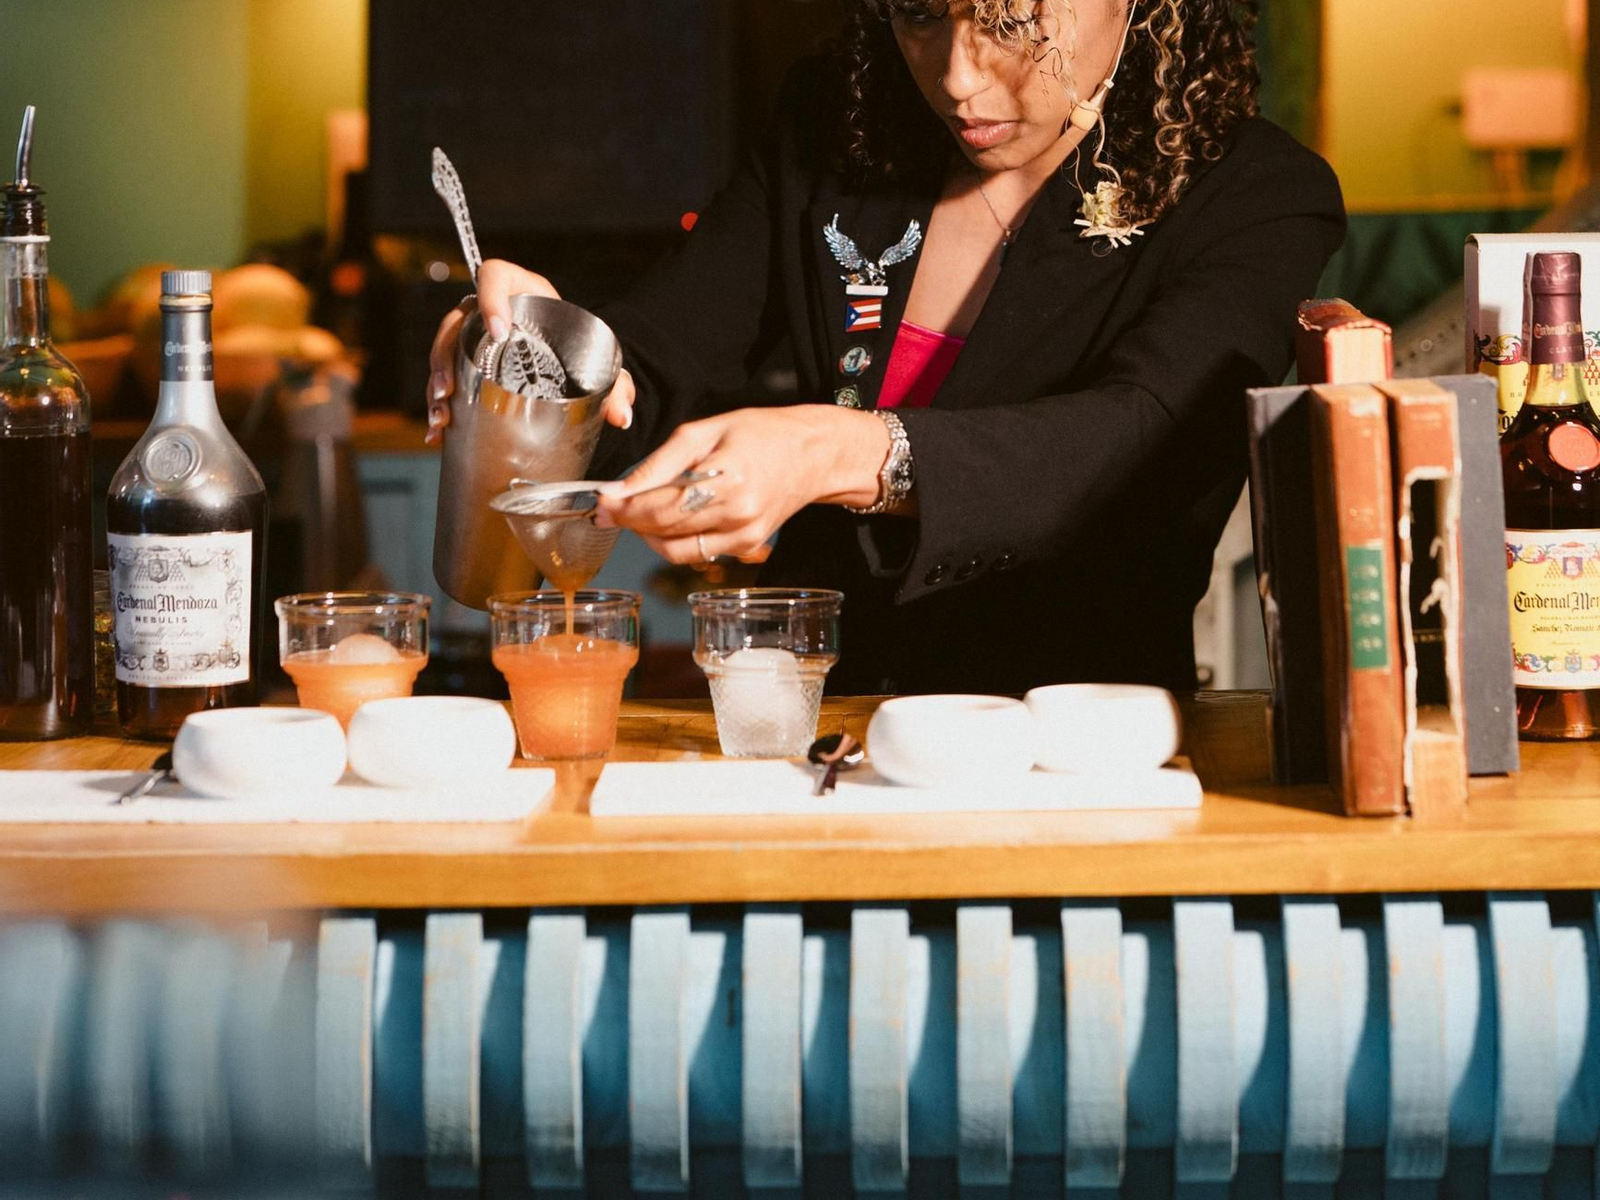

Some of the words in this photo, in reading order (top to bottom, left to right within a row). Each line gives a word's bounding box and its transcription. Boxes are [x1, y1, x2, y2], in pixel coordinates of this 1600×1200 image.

[117, 591, 157, 612] Cardenal
[157, 594, 218, 613] Mendoza
[1514, 591, 1571, 613] Cardenal
[135, 616, 188, 624] NEBULIS
